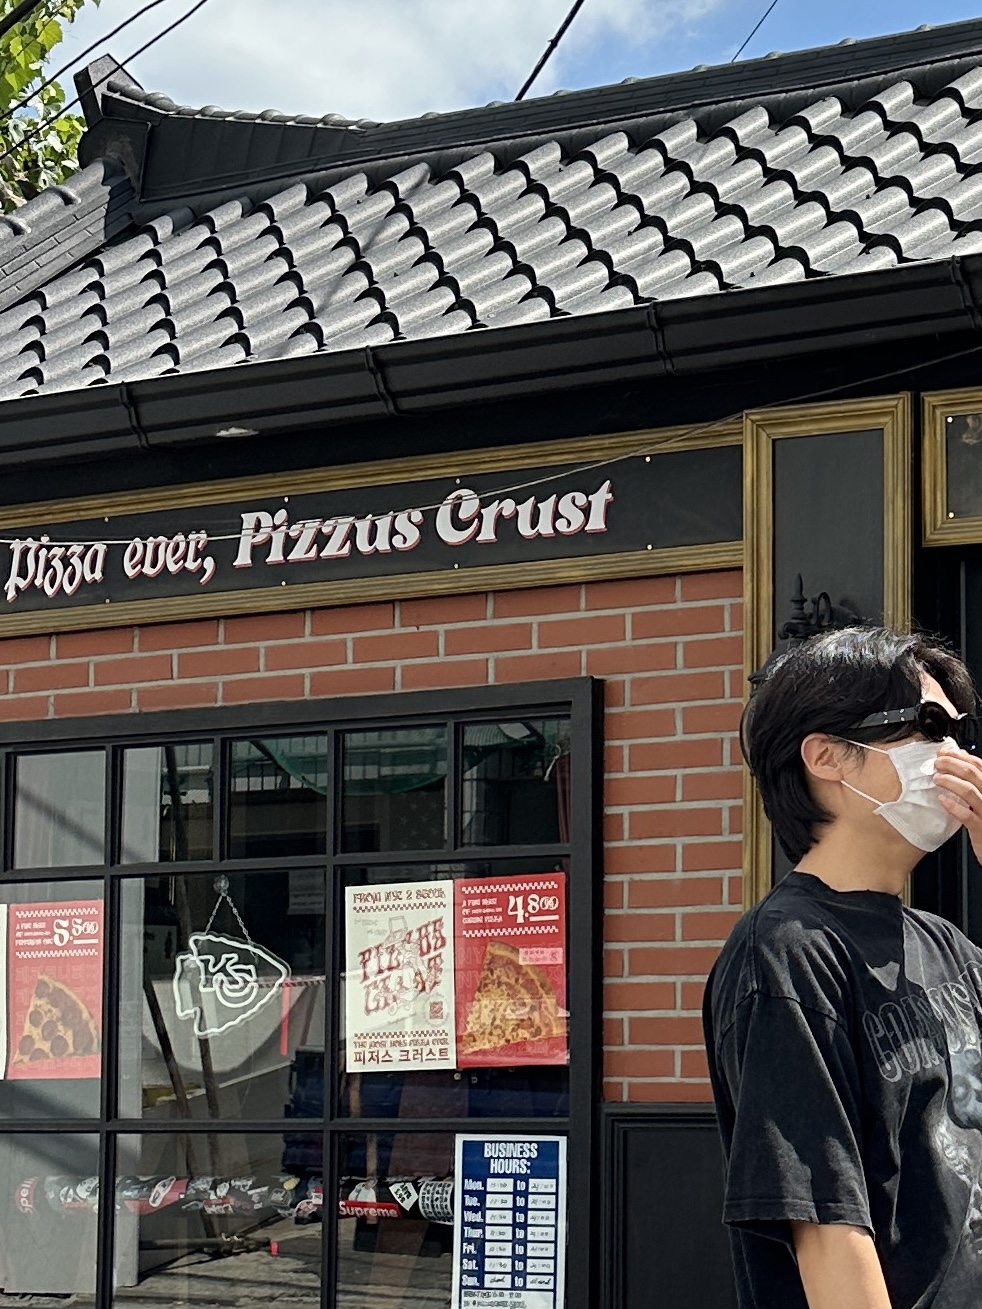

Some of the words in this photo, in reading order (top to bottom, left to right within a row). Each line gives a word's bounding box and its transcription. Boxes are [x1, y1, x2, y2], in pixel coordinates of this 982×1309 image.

[233, 508, 424, 568] Pizzus
[435, 480, 613, 546] Crust
[406, 890, 412, 900] 2
[353, 1049, 393, 1065] 피저스
[398, 1048, 450, 1063] 크러스트
[484, 1142, 538, 1158] BUSINESS
[490, 1159, 531, 1174] HOURS:
[464, 1179, 484, 1190] Mon.
[516, 1180, 526, 1190] to
[516, 1196, 525, 1206] to
[338, 1200, 399, 1218] Supreme
[515, 1212, 525, 1222] to
[515, 1228, 525, 1238] to
[462, 1243, 477, 1254] Fri.
[515, 1244, 524, 1255] to
[462, 1259, 479, 1270] Sat.
[514, 1260, 524, 1271] to
[514, 1276, 524, 1287] to
